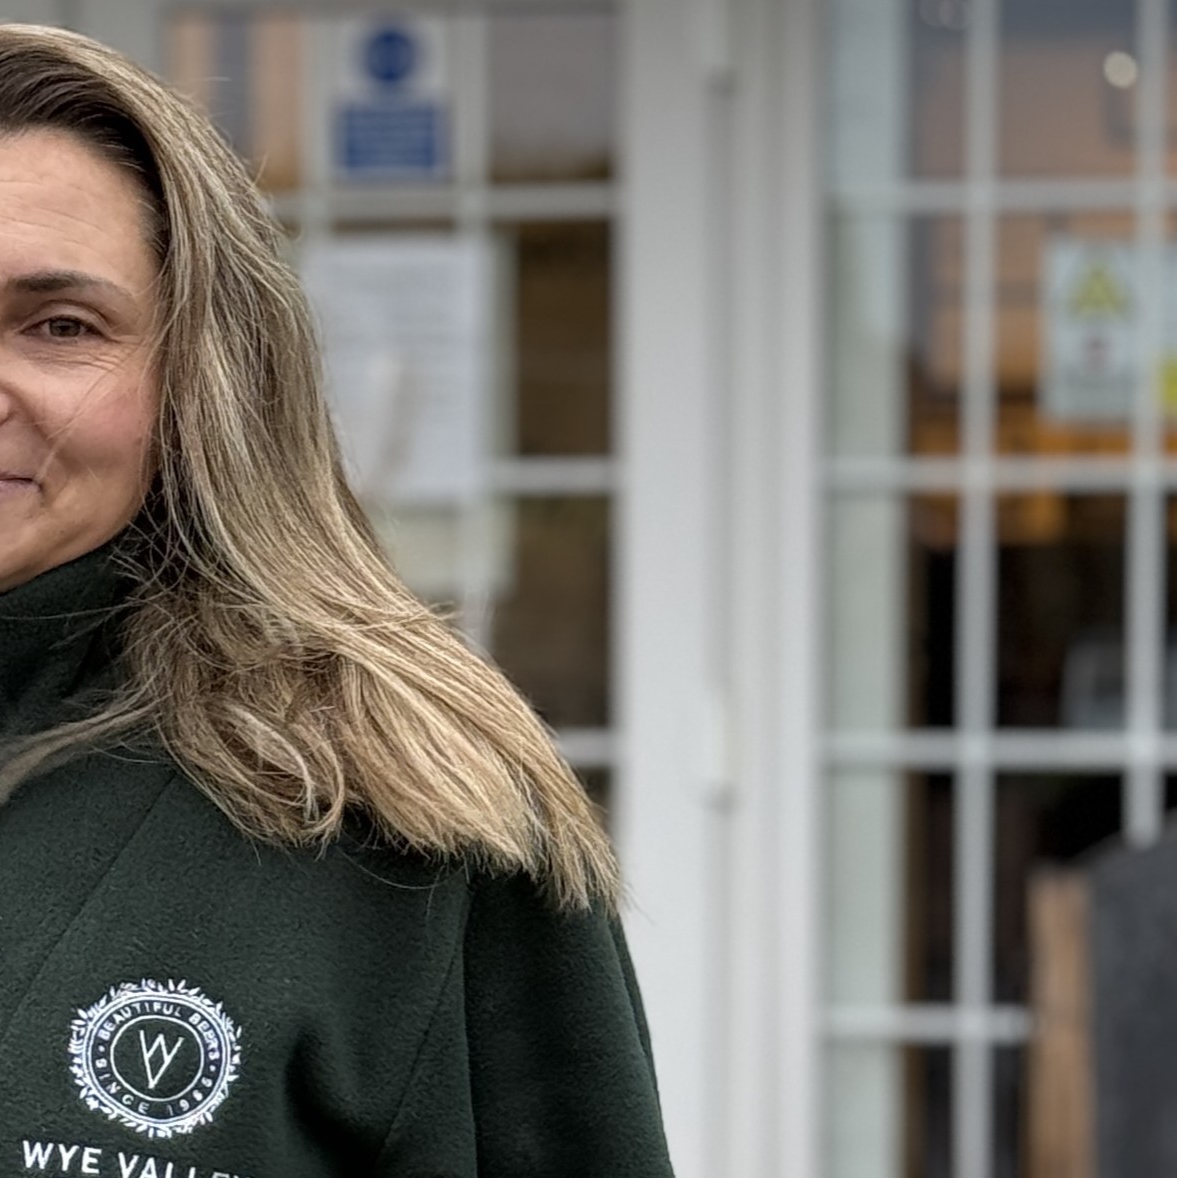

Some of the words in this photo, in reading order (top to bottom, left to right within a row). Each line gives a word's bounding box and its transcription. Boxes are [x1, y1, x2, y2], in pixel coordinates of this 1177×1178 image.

[97, 1001, 183, 1041] BEAUTIFUL
[188, 1012, 221, 1060] BEERS
[95, 1058, 150, 1114] SINCE
[22, 1140, 102, 1175] WYE
